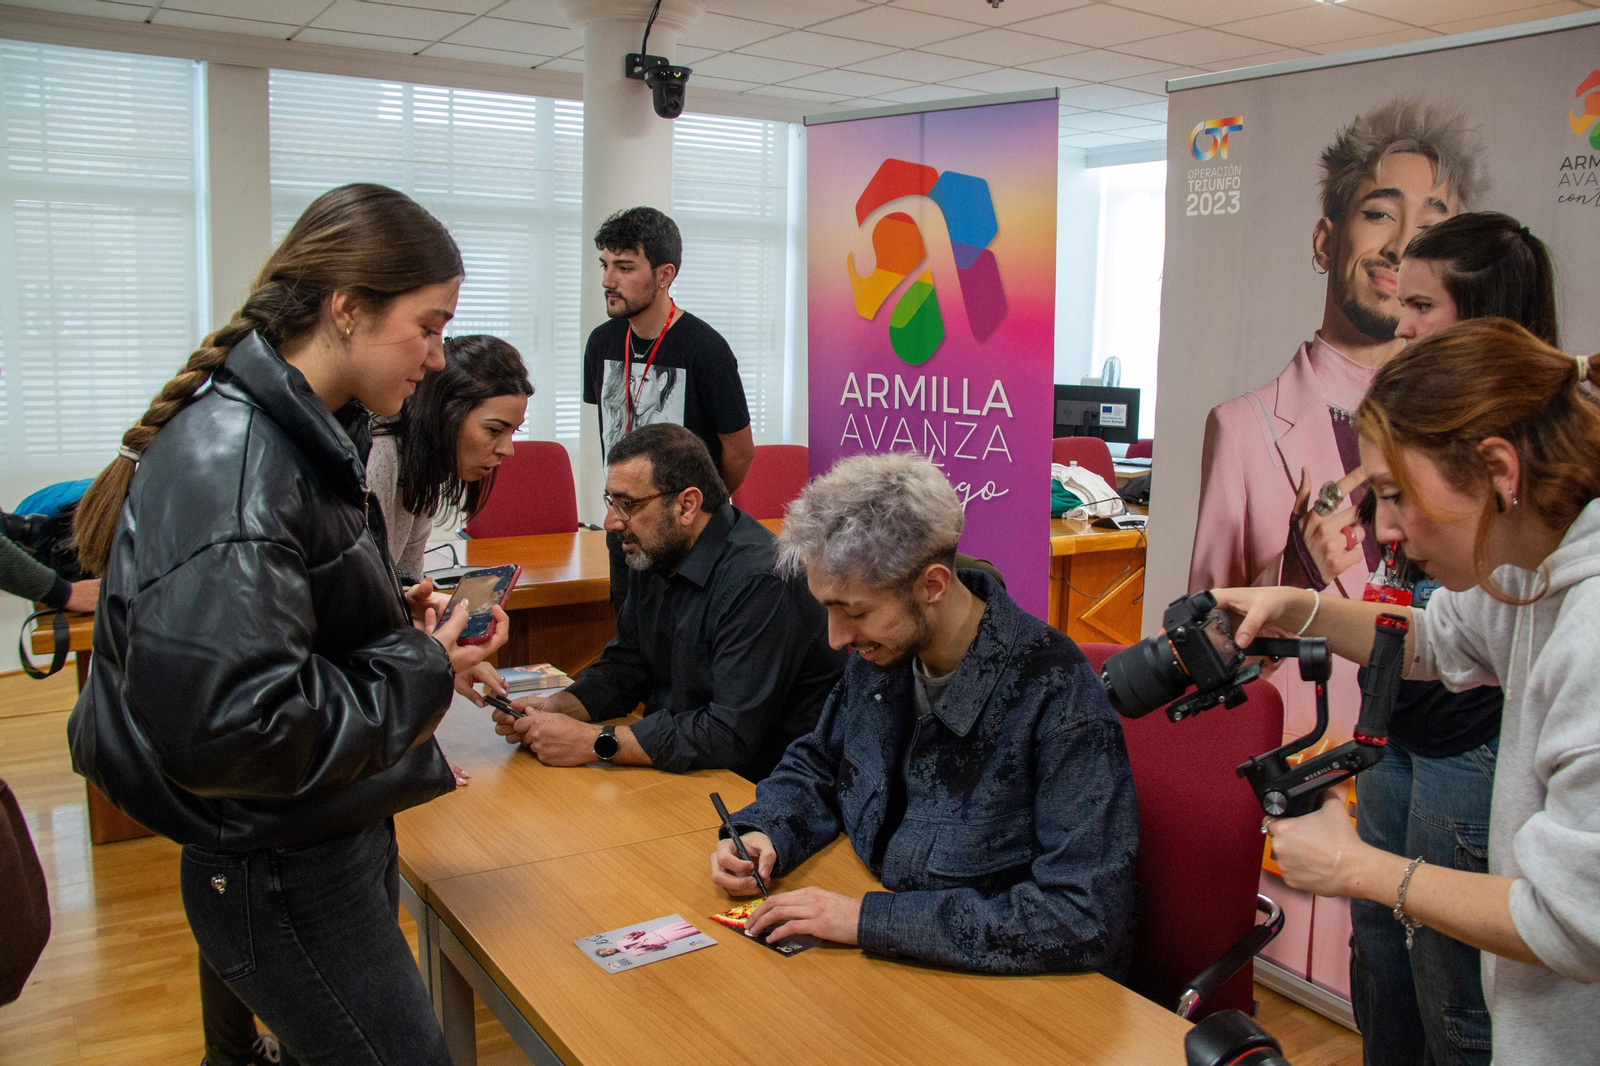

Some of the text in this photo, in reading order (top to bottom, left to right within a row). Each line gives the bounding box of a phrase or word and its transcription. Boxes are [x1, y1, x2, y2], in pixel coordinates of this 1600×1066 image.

[1187, 163, 1242, 179] OPERACIÓN
[1187, 176, 1241, 192] TRIUNFO
[1186, 190, 1241, 216] 2023
[840, 372, 1013, 418] ARMILLA
[840, 413, 1012, 463] AVANZA
